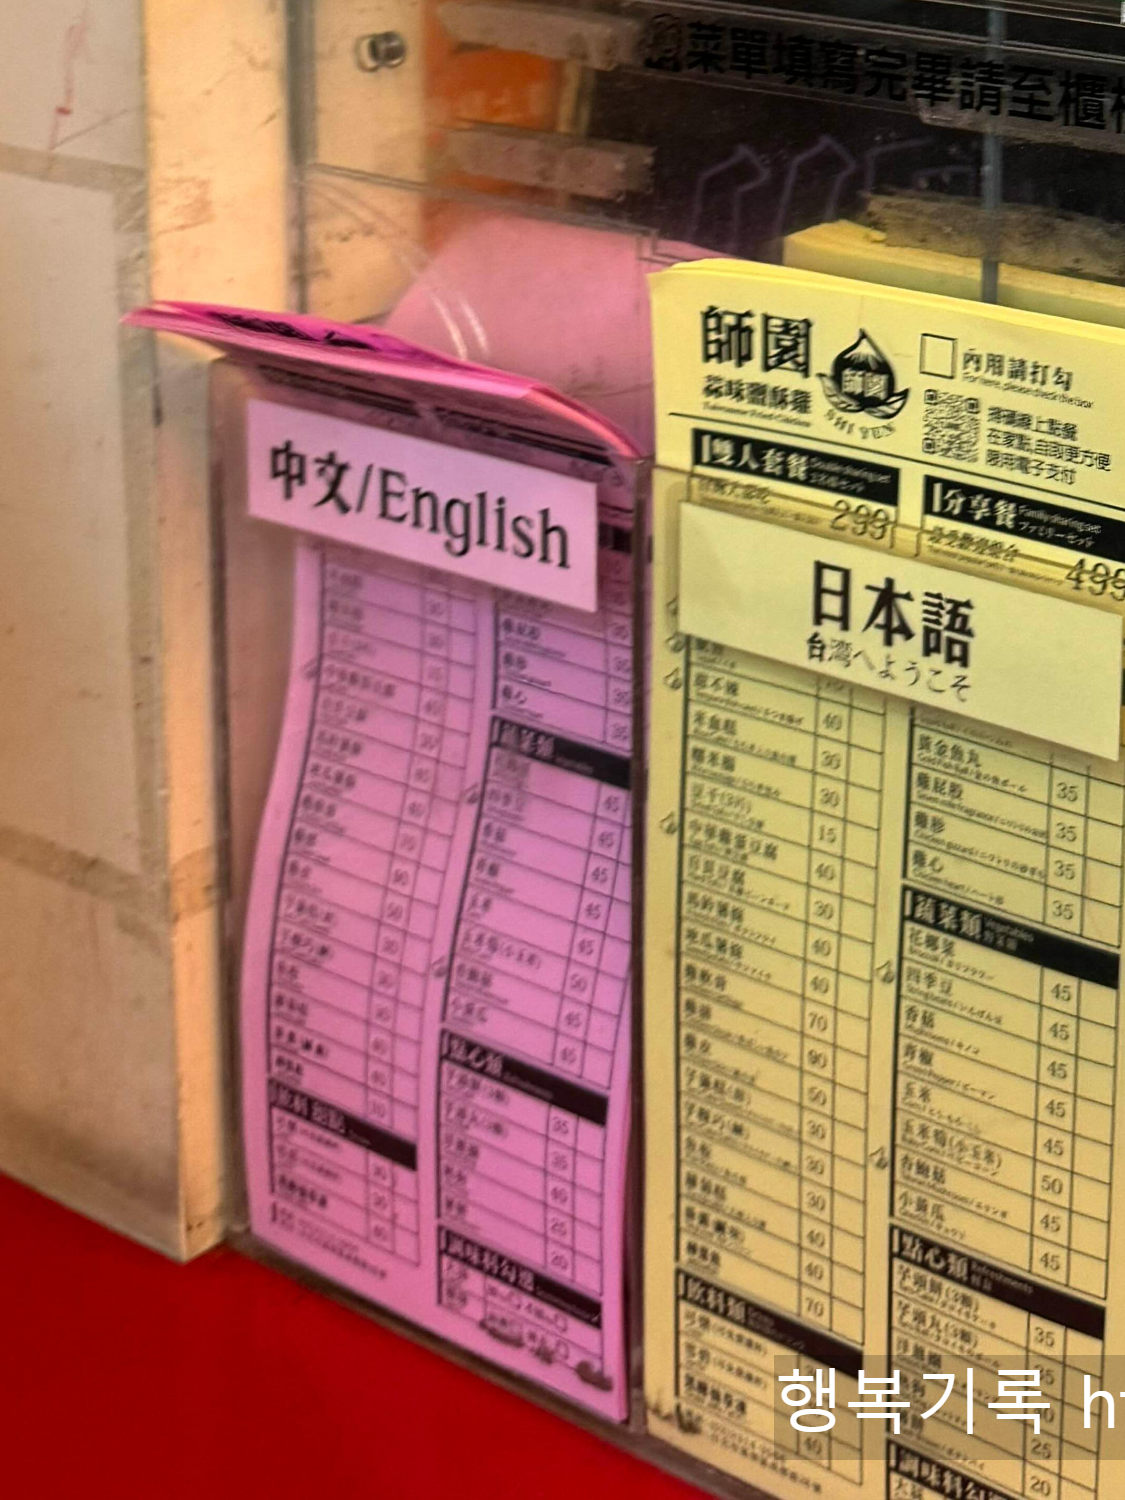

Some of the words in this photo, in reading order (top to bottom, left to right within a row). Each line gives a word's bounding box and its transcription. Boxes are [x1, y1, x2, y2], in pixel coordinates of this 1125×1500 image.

[701, 305, 813, 378] 師園
[270, 439, 571, 569] 中文/English
[813, 560, 975, 668] 日本語
